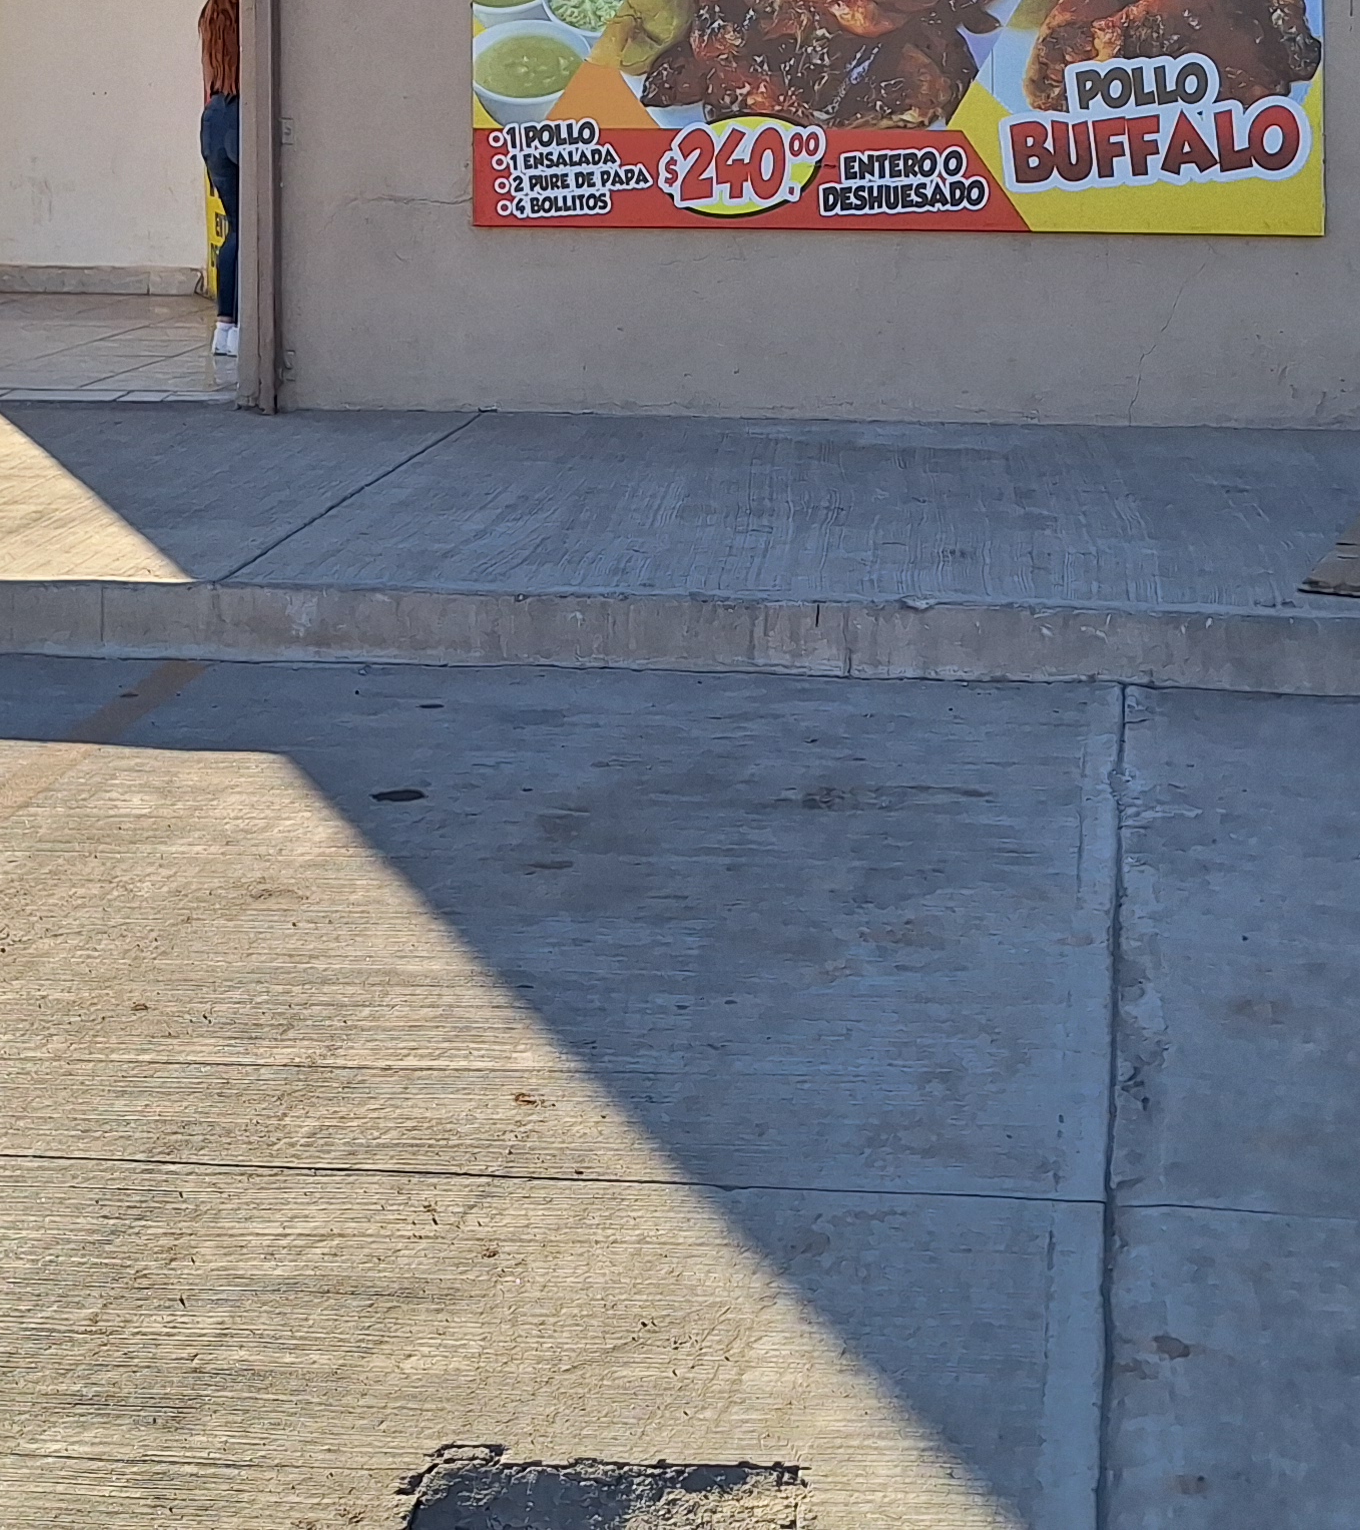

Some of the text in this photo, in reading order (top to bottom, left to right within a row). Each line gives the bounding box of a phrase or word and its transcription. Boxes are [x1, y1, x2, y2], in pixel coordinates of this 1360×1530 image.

[1075, 62, 1208, 109] POLLO
[505, 121, 596, 149] 1 POLLO
[1009, 105, 1301, 184] BUFFALO
[507, 147, 616, 169] 1 ENSALADA
[844, 150, 962, 181] ENTERO O
[512, 168, 650, 193] 2 PURE DE PAPA
[516, 193, 610, 215] 4 BOLLITOS
[822, 182, 986, 213] DESHUESADO
